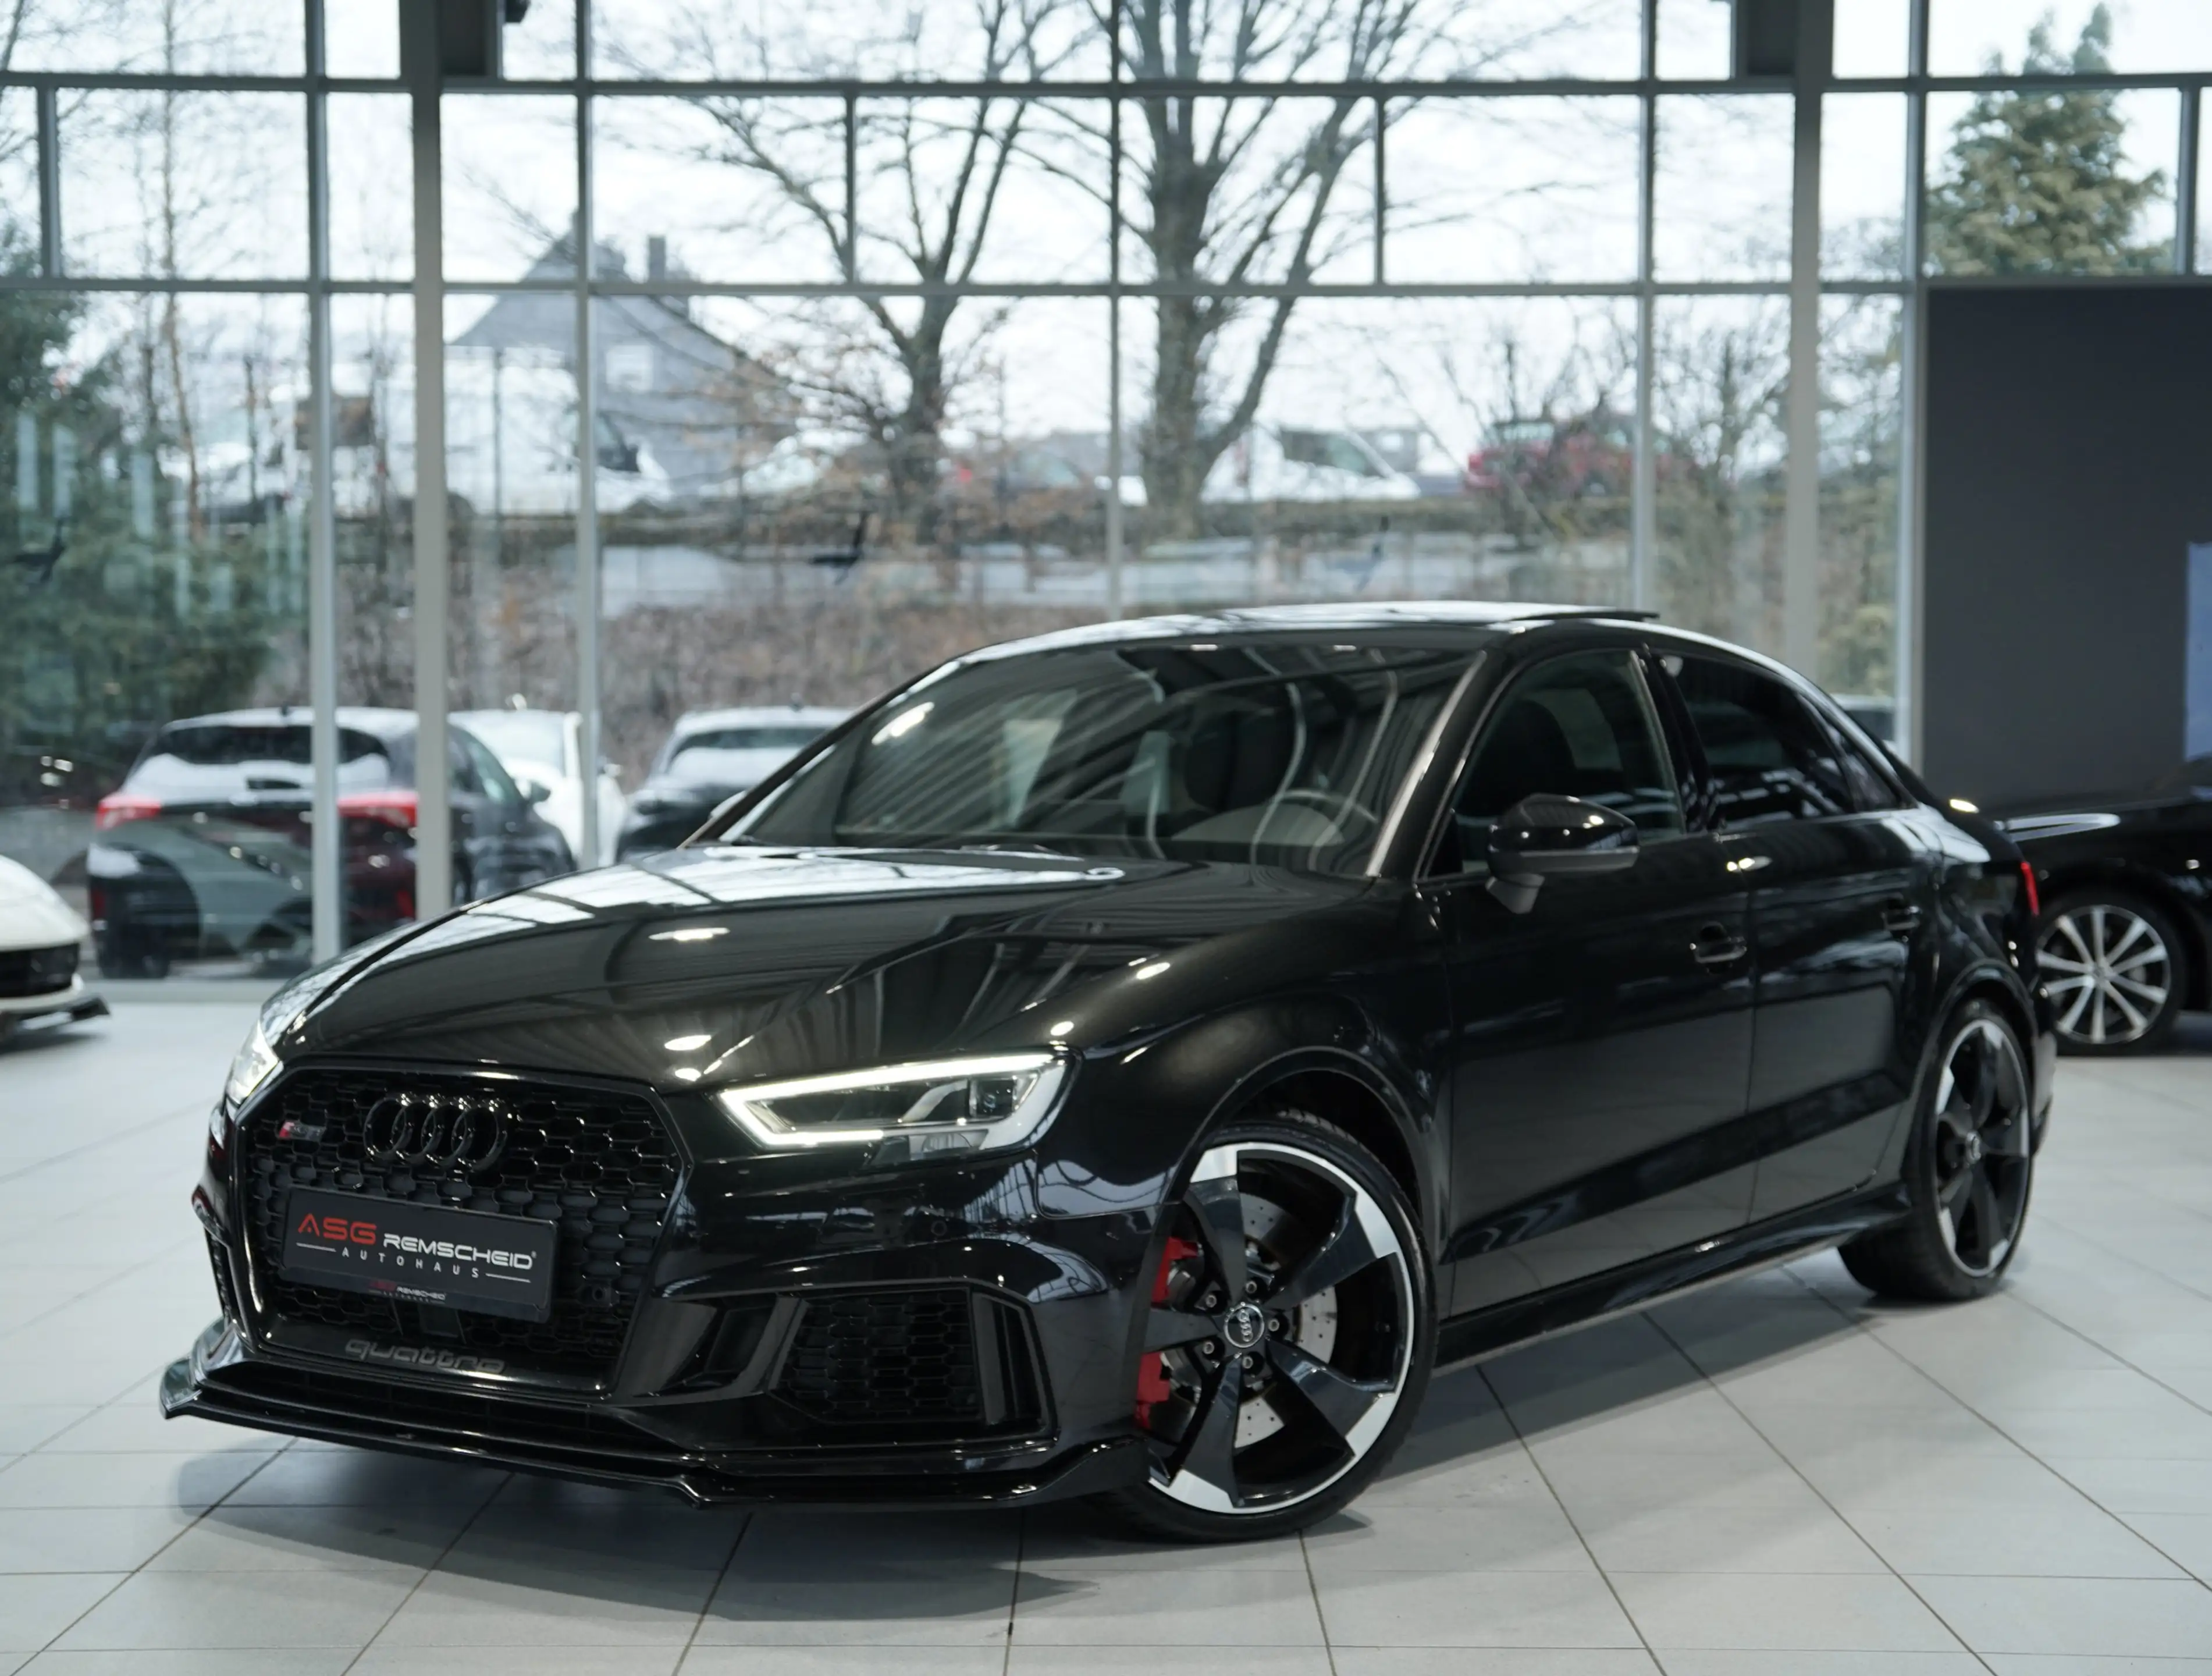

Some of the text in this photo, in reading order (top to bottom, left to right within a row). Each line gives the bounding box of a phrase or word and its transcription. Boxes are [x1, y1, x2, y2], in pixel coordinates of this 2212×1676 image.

[297, 1213, 377, 1245] ASG
[342, 1247, 479, 1279] AUTOHAUS
[344, 1338, 506, 1374] quattro
